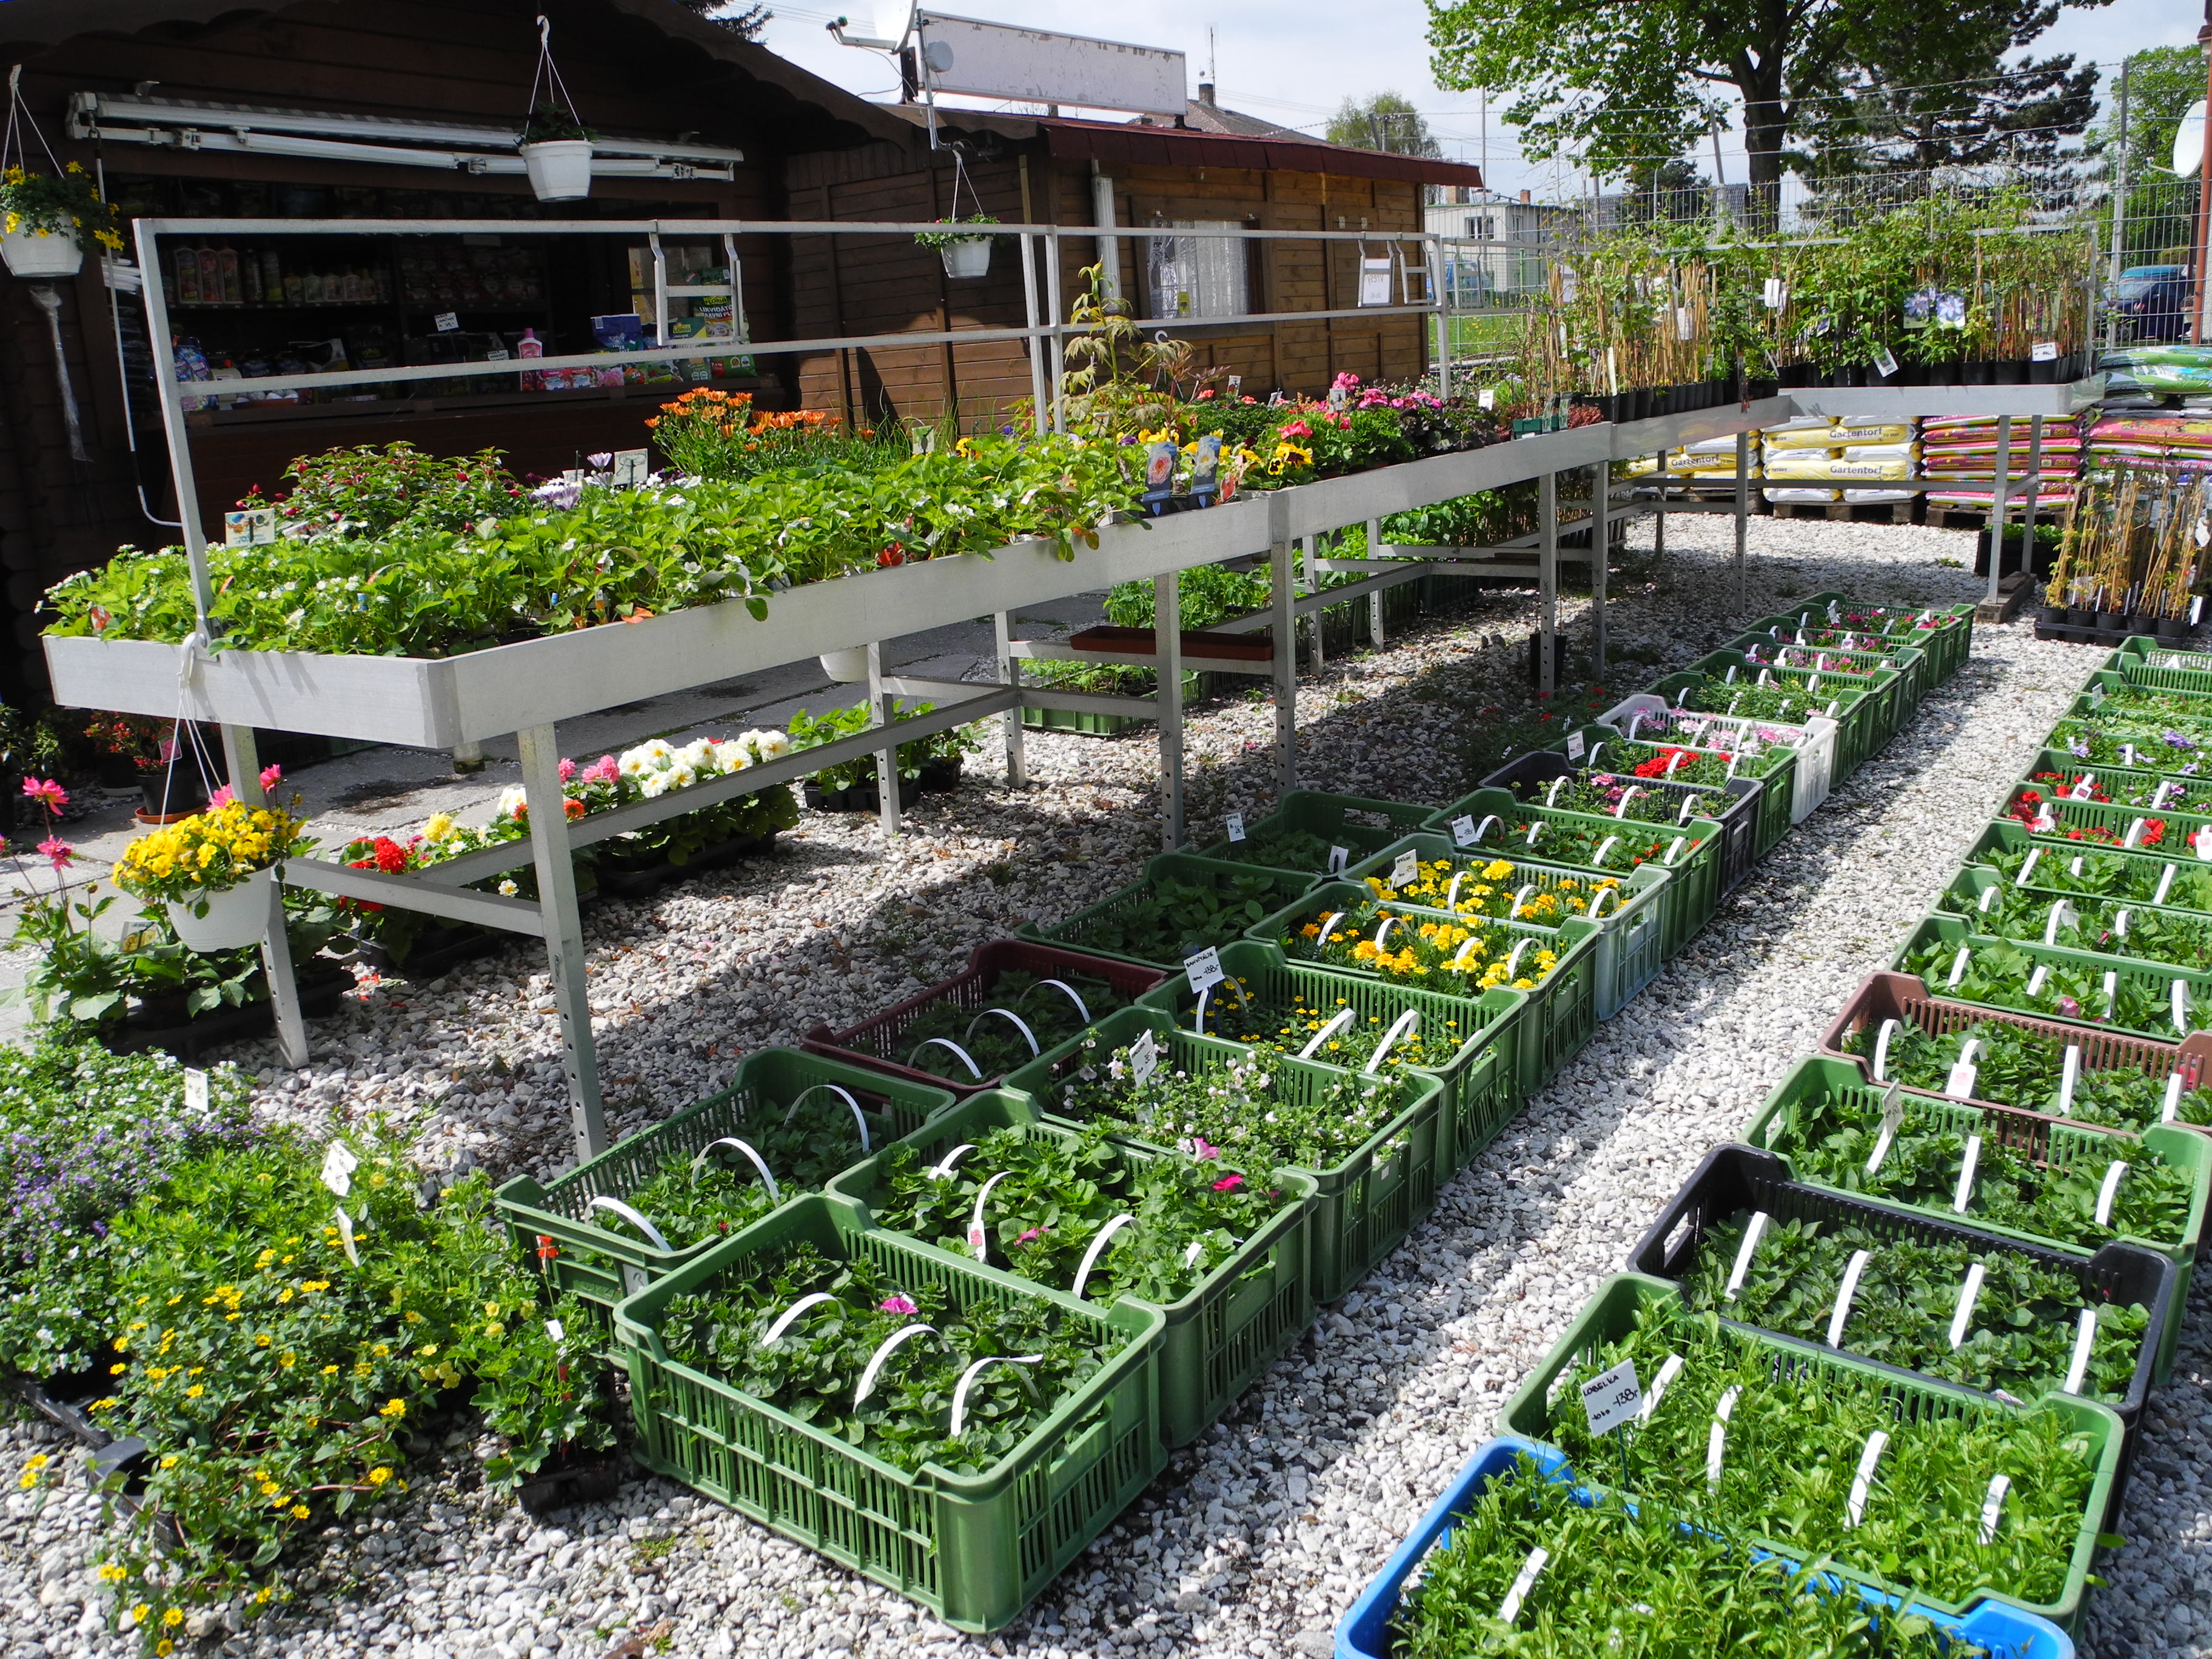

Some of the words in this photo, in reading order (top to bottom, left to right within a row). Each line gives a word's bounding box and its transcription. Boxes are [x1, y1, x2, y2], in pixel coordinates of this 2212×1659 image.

[1829, 427, 1883, 438] Gartentorf
[1671, 454, 1720, 466] Gartentorf
[1583, 1375, 1620, 1396] LOBELKA
